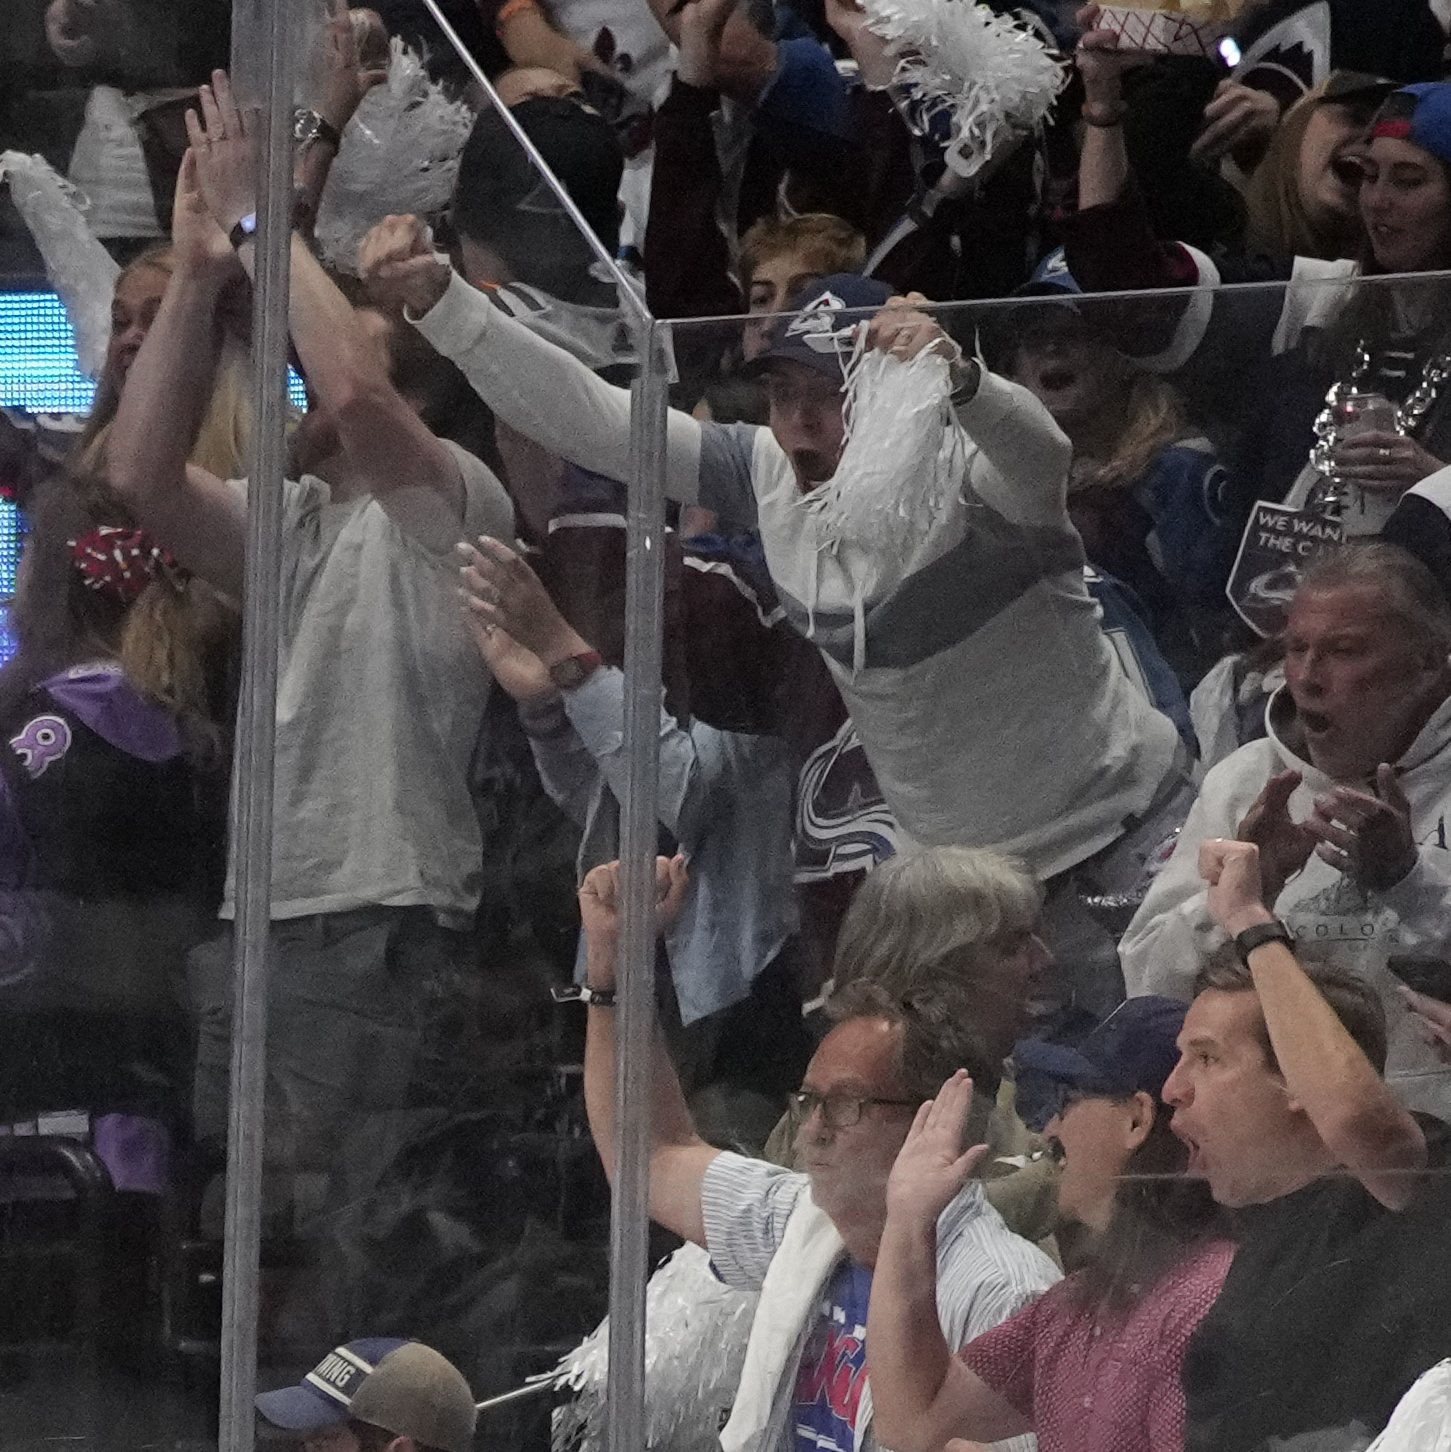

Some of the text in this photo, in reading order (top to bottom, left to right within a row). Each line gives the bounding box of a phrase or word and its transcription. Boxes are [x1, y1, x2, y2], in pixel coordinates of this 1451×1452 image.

[1259, 511, 1288, 531] WE
[1259, 532, 1293, 553] THE
[1296, 922, 1377, 939] COLO
